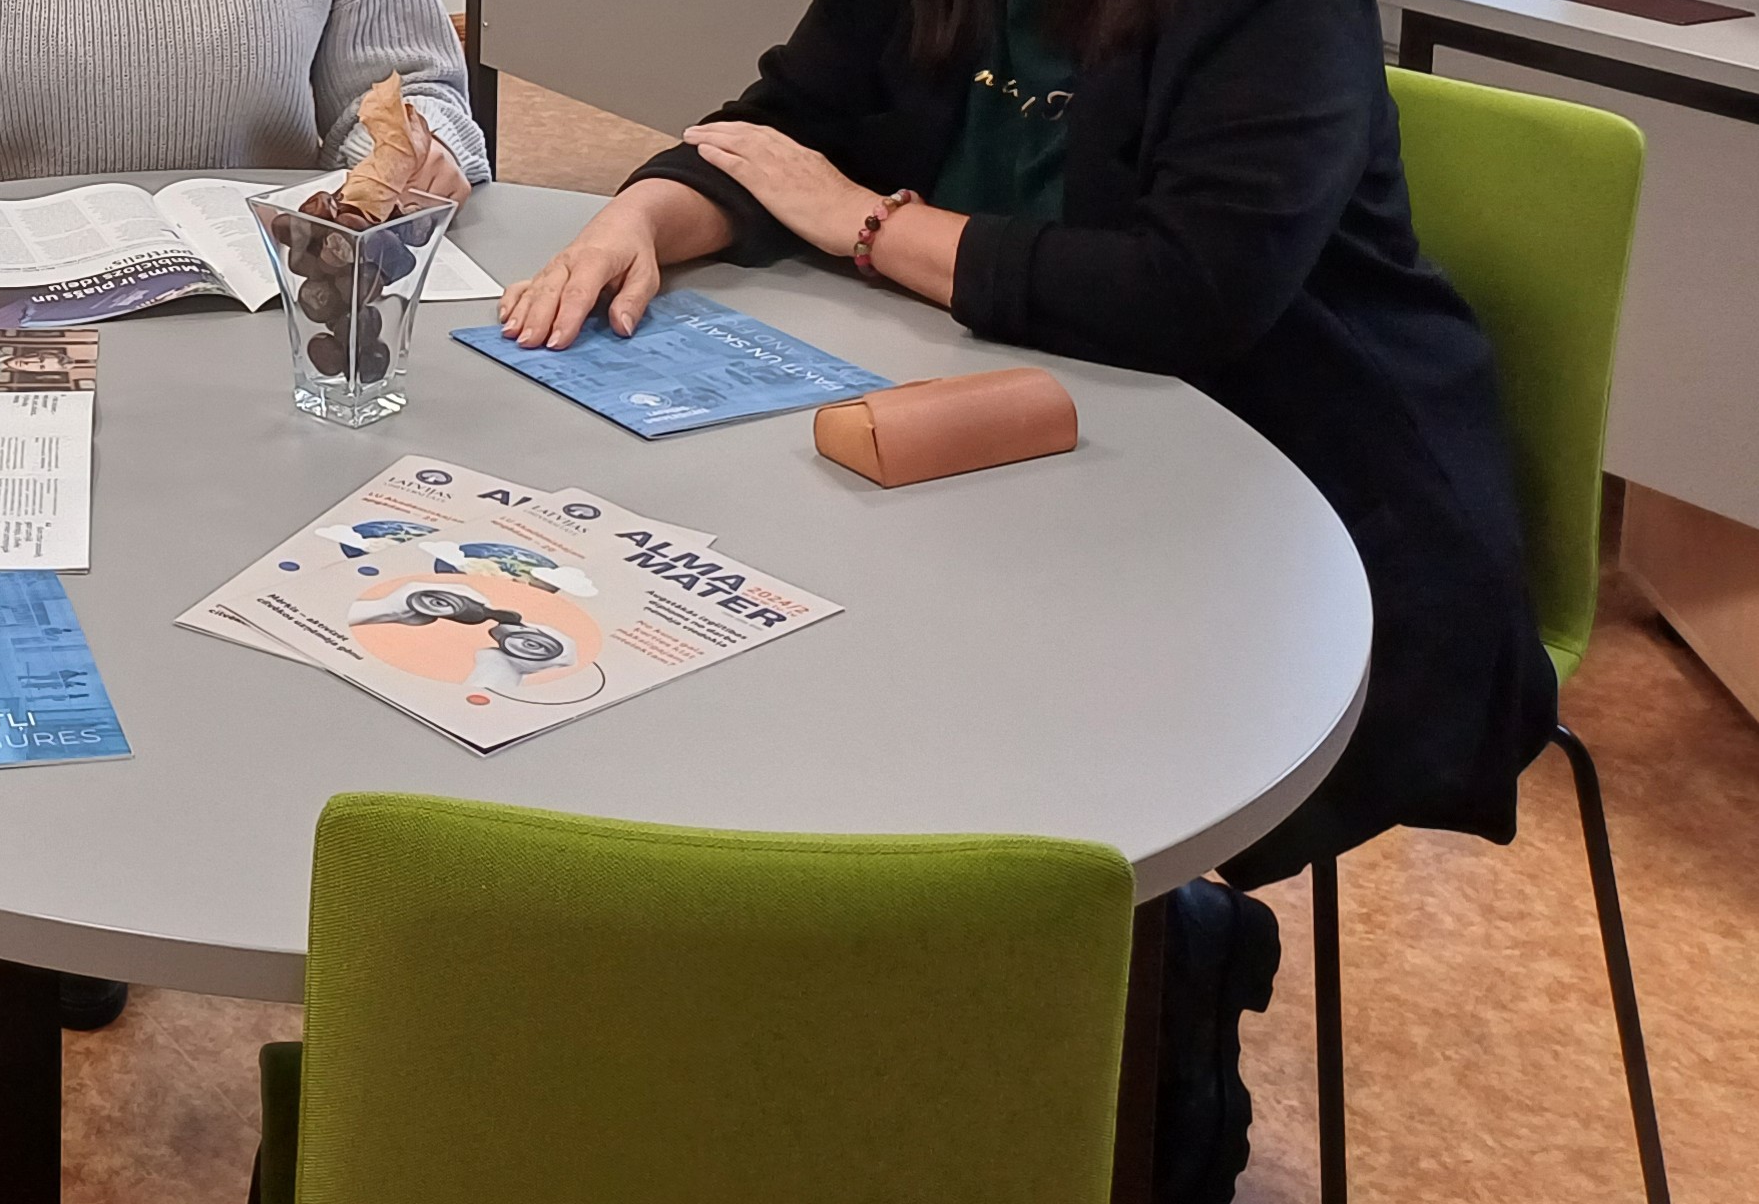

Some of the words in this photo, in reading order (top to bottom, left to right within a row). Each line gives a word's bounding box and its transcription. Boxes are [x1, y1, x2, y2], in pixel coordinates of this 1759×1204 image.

[48, 276, 100, 294] ideju
[118, 274, 137, 288] ir
[30, 294, 59, 305] un
[750, 345, 782, 365] UN
[780, 361, 845, 392] FAKTI
[614, 530, 747, 591] ALMA
[623, 552, 787, 628] MATER
[746, 586, 810, 614] 2024/2
